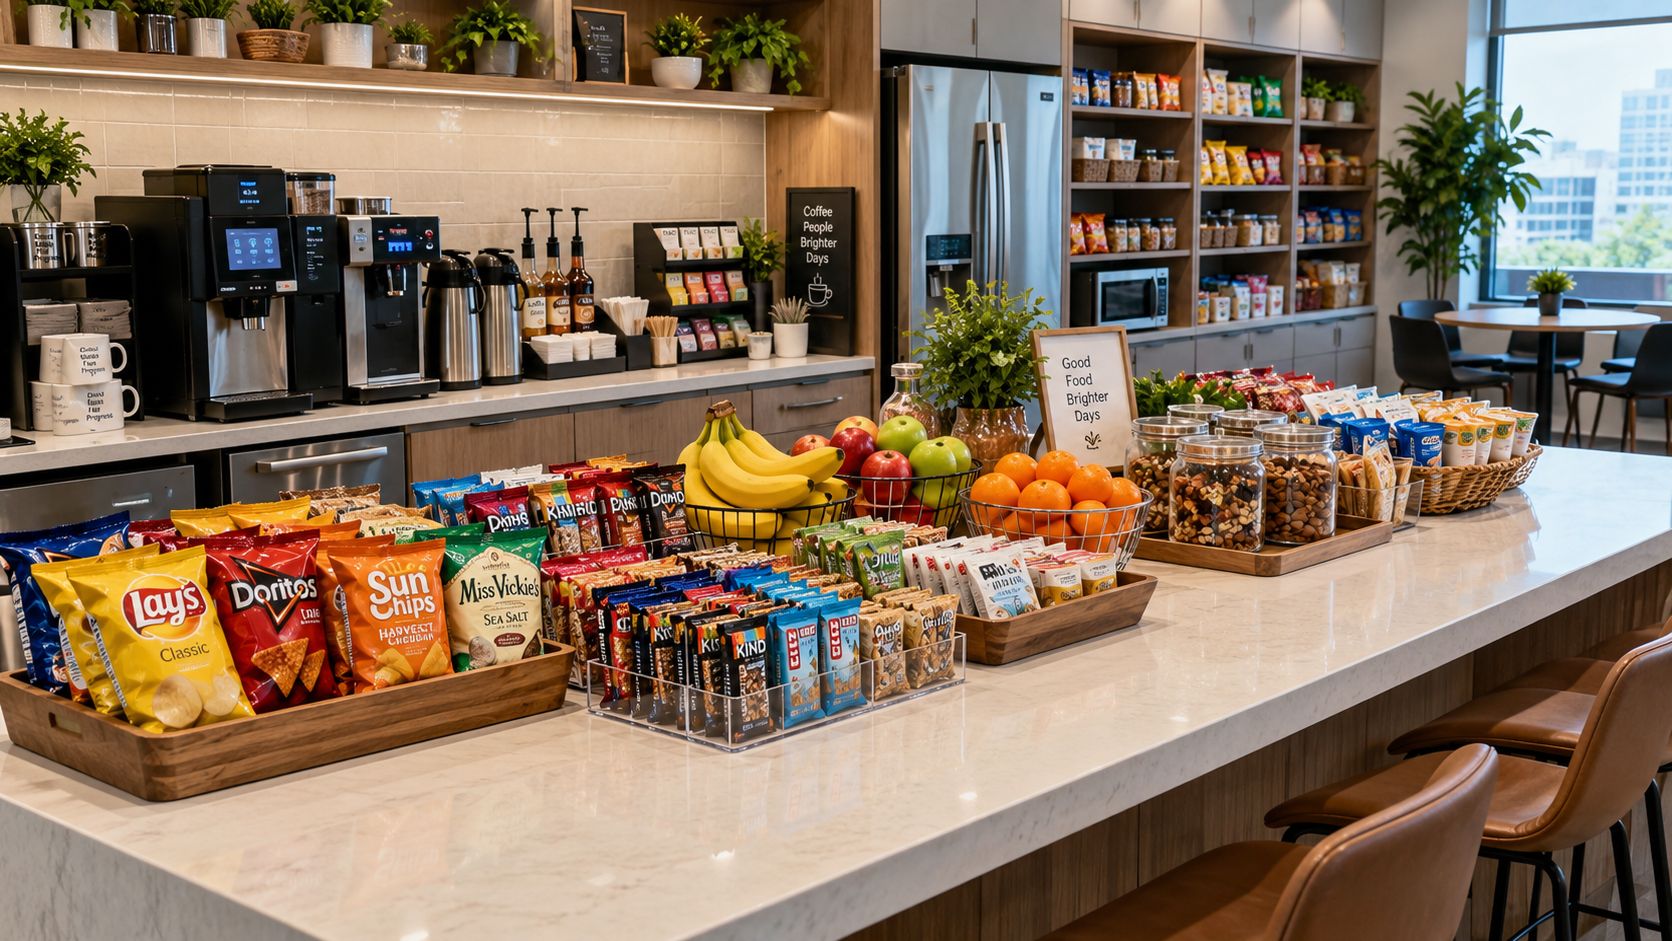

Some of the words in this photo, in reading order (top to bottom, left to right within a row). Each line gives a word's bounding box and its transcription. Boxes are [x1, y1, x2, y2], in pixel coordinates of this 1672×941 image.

[803, 205, 833, 217] Coffee
[803, 221, 833, 235] People
[800, 236, 838, 251] Brighter
[806, 252, 829, 267] Days
[1062, 355, 1091, 370] Good
[1065, 373, 1093, 387] Food
[1066, 391, 1109, 407] Brighter
[1074, 409, 1101, 424] Days
[231, 577, 318, 610] Doritos
[367, 570, 430, 605] Sun
[459, 577, 495, 606] Miss
[492, 573, 540, 600] Vickie's
[129, 584, 200, 629] Lay's
[370, 595, 436, 621] Chips
[483, 612, 504, 627] SEA
[505, 610, 529, 625] SALT
[159, 641, 210, 662] Classic
[735, 639, 767, 660] KIND
